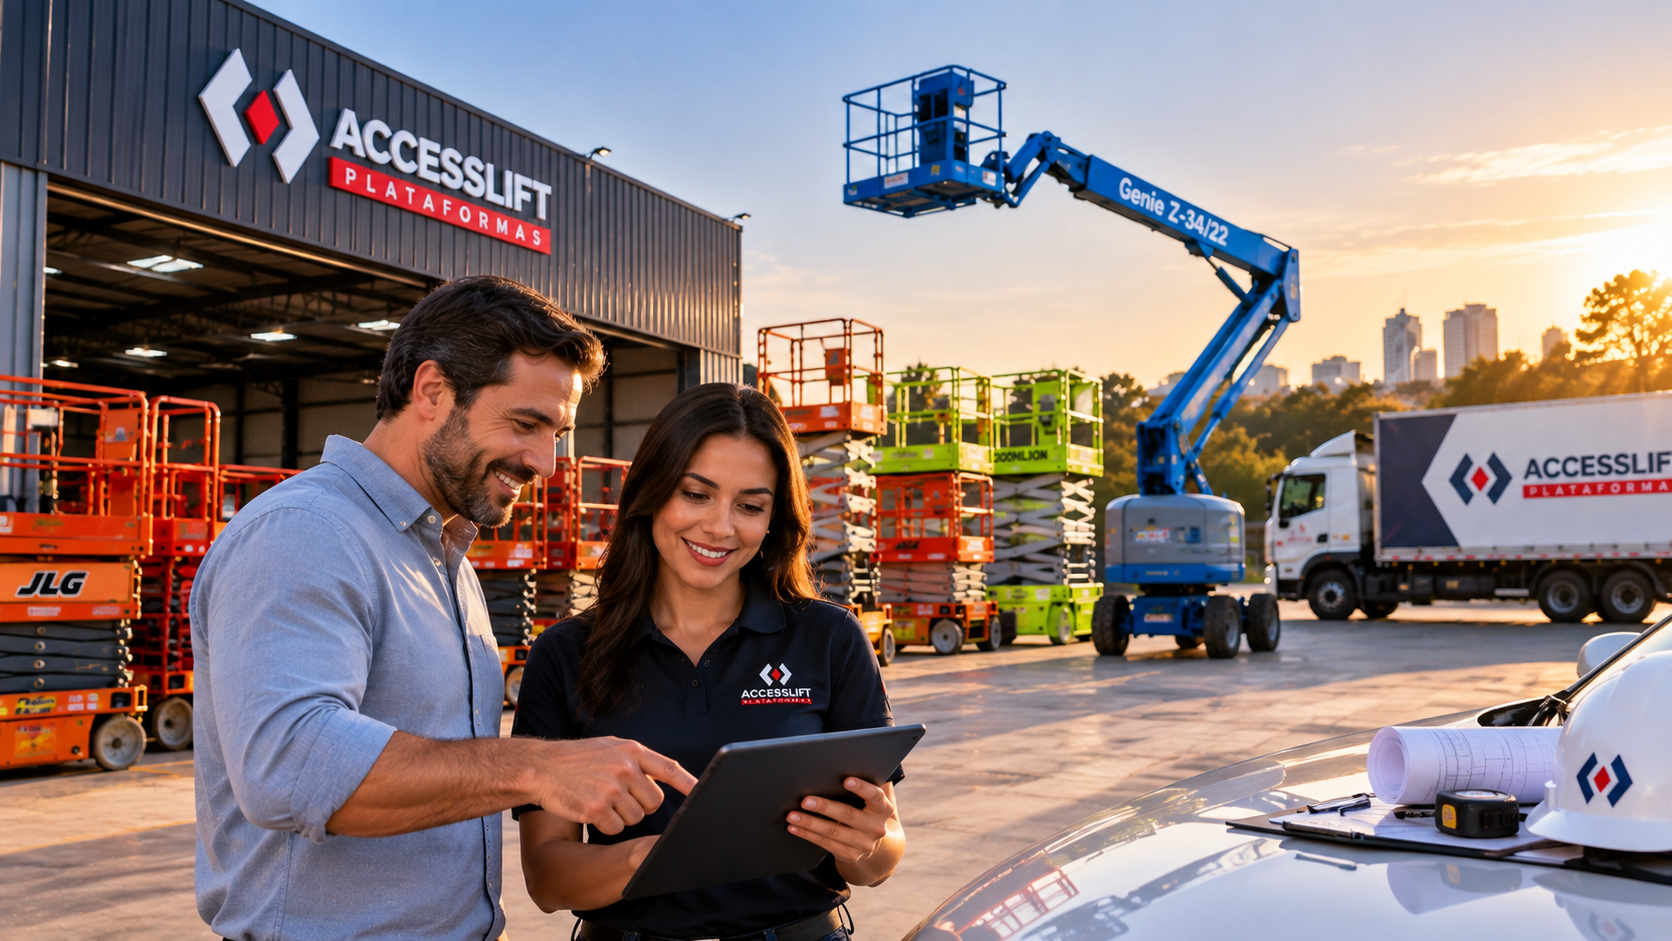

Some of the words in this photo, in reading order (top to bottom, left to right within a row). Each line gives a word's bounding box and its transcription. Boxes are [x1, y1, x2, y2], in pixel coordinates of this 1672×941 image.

[330, 108, 552, 220] ACCESSLIFT
[345, 167, 541, 246] PLATAFORMAS
[1119, 177, 1165, 216] Genie
[1168, 200, 1229, 247] Z-34/22
[1524, 452, 1672, 479] ACCESSLIF
[15, 570, 90, 597] JLG
[741, 688, 811, 699] ACCESSLIFT
